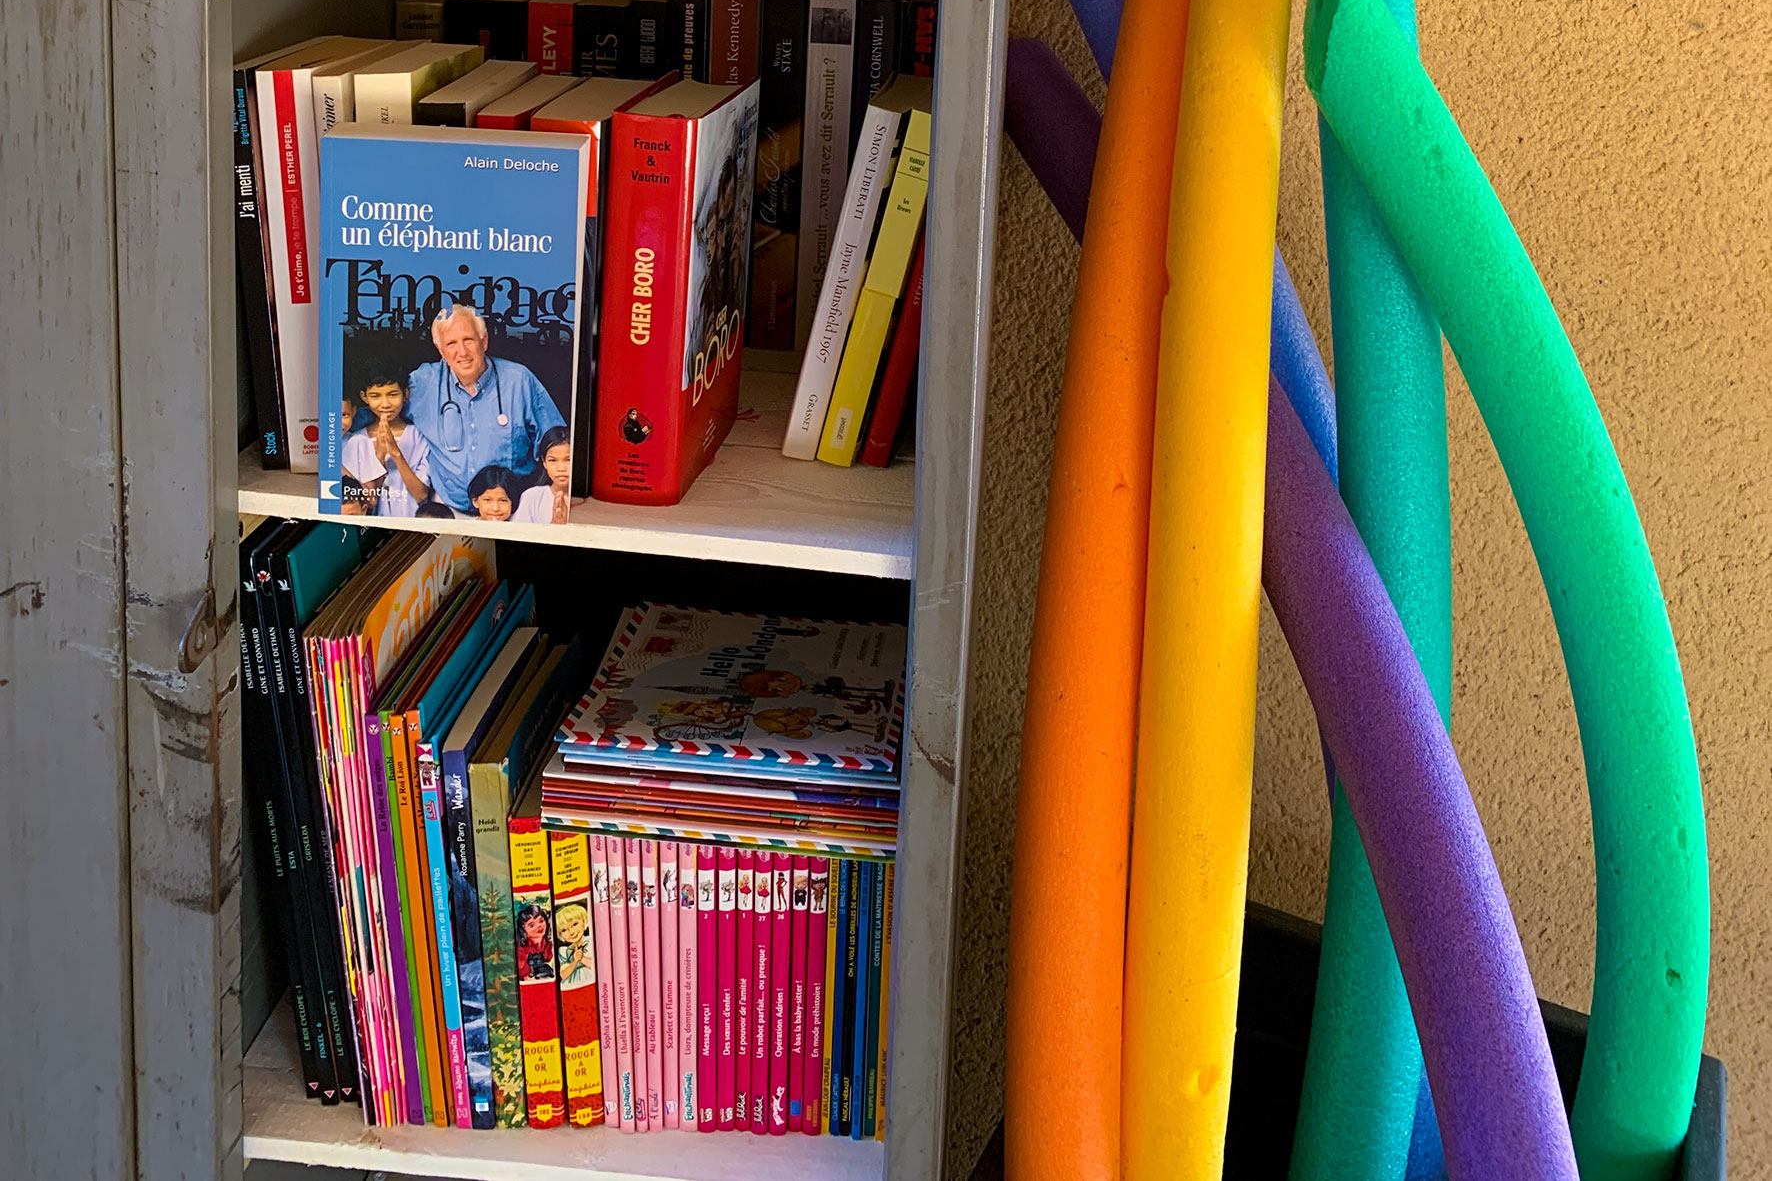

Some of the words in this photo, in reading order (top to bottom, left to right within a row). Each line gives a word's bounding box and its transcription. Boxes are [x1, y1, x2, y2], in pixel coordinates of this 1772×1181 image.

[682, 3, 695, 45] preuves
[726, 0, 744, 62] Kennedy
[543, 25, 557, 71] LEVY
[781, 38, 792, 73] STACE
[869, 15, 885, 79] CORNWELL
[821, 69, 836, 121] Serrault
[284, 122, 294, 150] PEREL
[633, 137, 671, 153] Franck
[820, 125, 833, 142] dit
[869, 124, 887, 165] SIMON
[286, 151, 296, 185] ESTHER
[464, 156, 498, 169] Alain
[503, 158, 559, 172] Deloche
[646, 155, 656, 167] &
[821, 145, 831, 175] avez
[235, 164, 253, 196] menti
[631, 170, 670, 184] Vautrin
[341, 195, 433, 222] Comme
[854, 167, 877, 220] LIBERATI
[238, 201, 256, 219] J'ai
[341, 226, 371, 246] un
[378, 222, 482, 253] éléphant
[488, 227, 552, 253] blanc
[633, 247, 655, 298] BORO
[840, 242, 858, 274] Jayne
[825, 276, 850, 334] Mansfield
[630, 302, 652, 346] CHER
[816, 336, 832, 364] 1967
[801, 394, 818, 432] GRASSET
[264, 431, 278, 455] Stock
[327, 412, 336, 468] TÉMOIGNAGE
[251, 627, 264, 664] CONVARD
[268, 626, 280, 659] DETHAN
[274, 658, 285, 694] ISABELLE
[700, 646, 740, 677] Hello
[259, 674, 269, 695] GINE
[373, 758, 383, 782] neiges
[386, 756, 396, 781] Bambi
[396, 761, 405, 779] Lion
[375, 783, 384, 796] des
[398, 780, 407, 794] Roi
[400, 795, 408, 806] Le
[450, 773, 465, 810] Wander
[265, 800, 276, 827] MORTS
[378, 798, 387, 820] Reine
[300, 825, 312, 862] GRISELDA
[456, 821, 467, 842] Parry
[272, 845, 283, 867] PUITS
[288, 851, 297, 870] ESTA
[457, 843, 469, 876] Rosanne
[433, 867, 445, 910] paillettes
[439, 926, 449, 948] plein
[442, 951, 451, 973] hiver
[684, 948, 692, 980] crinières
[758, 949, 767, 979] presque
[873, 940, 881, 967] CONTES
[298, 994, 309, 1026] CYCLOPE
[601, 983, 609, 1015] Rainbow
[684, 993, 693, 1033] dompteuse
[775, 992, 783, 1018] Adrien
[794, 984, 803, 1022] baby-sitter
[603, 1023, 611, 1050] Sophia
[666, 1020, 674, 1049] Scarlett
[703, 1025, 712, 1056] Message
[740, 1017, 748, 1045] pouvoir
[775, 1019, 784, 1058] Opération
[317, 1034, 326, 1059] FINKEL
[525, 1044, 555, 1055] ROUGE
[534, 1063, 547, 1072] OR
